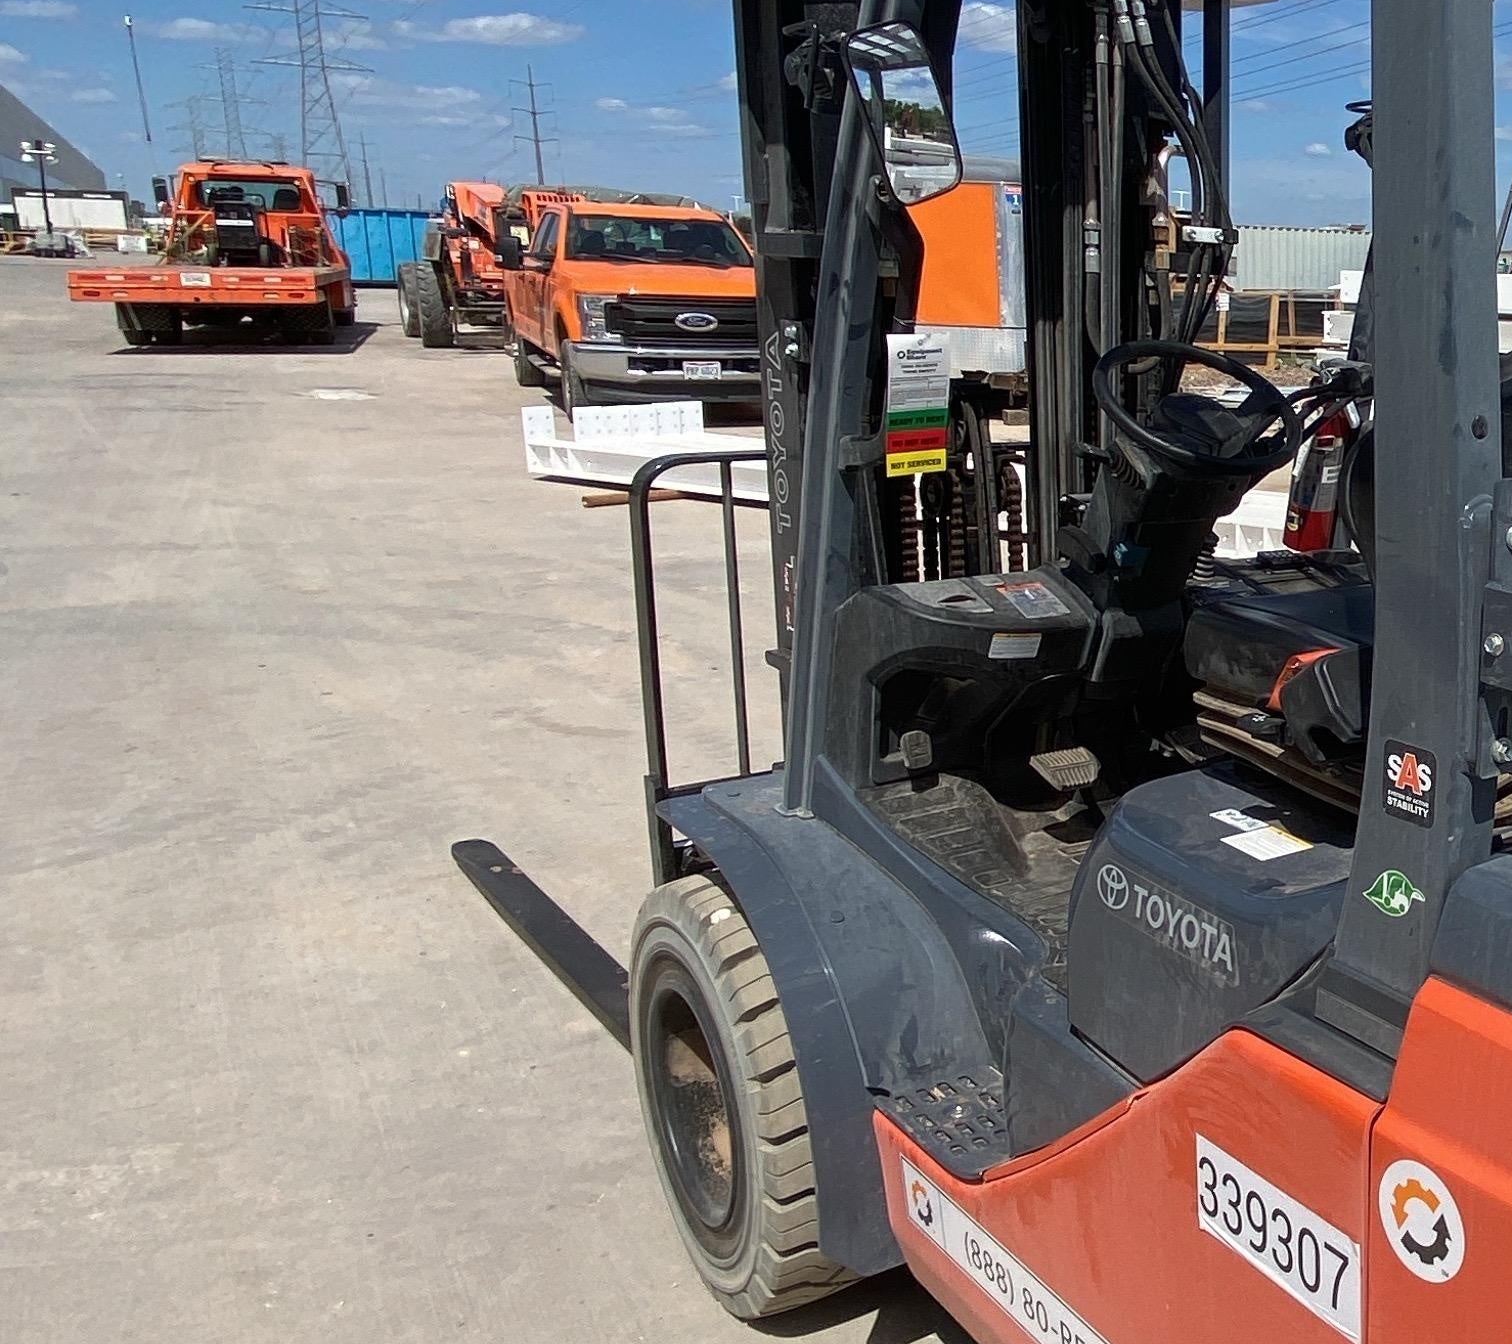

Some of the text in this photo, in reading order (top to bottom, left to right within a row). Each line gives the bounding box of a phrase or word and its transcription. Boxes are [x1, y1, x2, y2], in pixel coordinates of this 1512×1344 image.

[765, 331, 792, 534] TOYOTA
[1387, 752, 1432, 796] SAS
[1387, 795, 1430, 818] STABILITY
[1134, 884, 1233, 972] TOYOTA
[964, 1230, 1015, 1306] (888)
[1198, 1156, 1350, 1311] 339307
